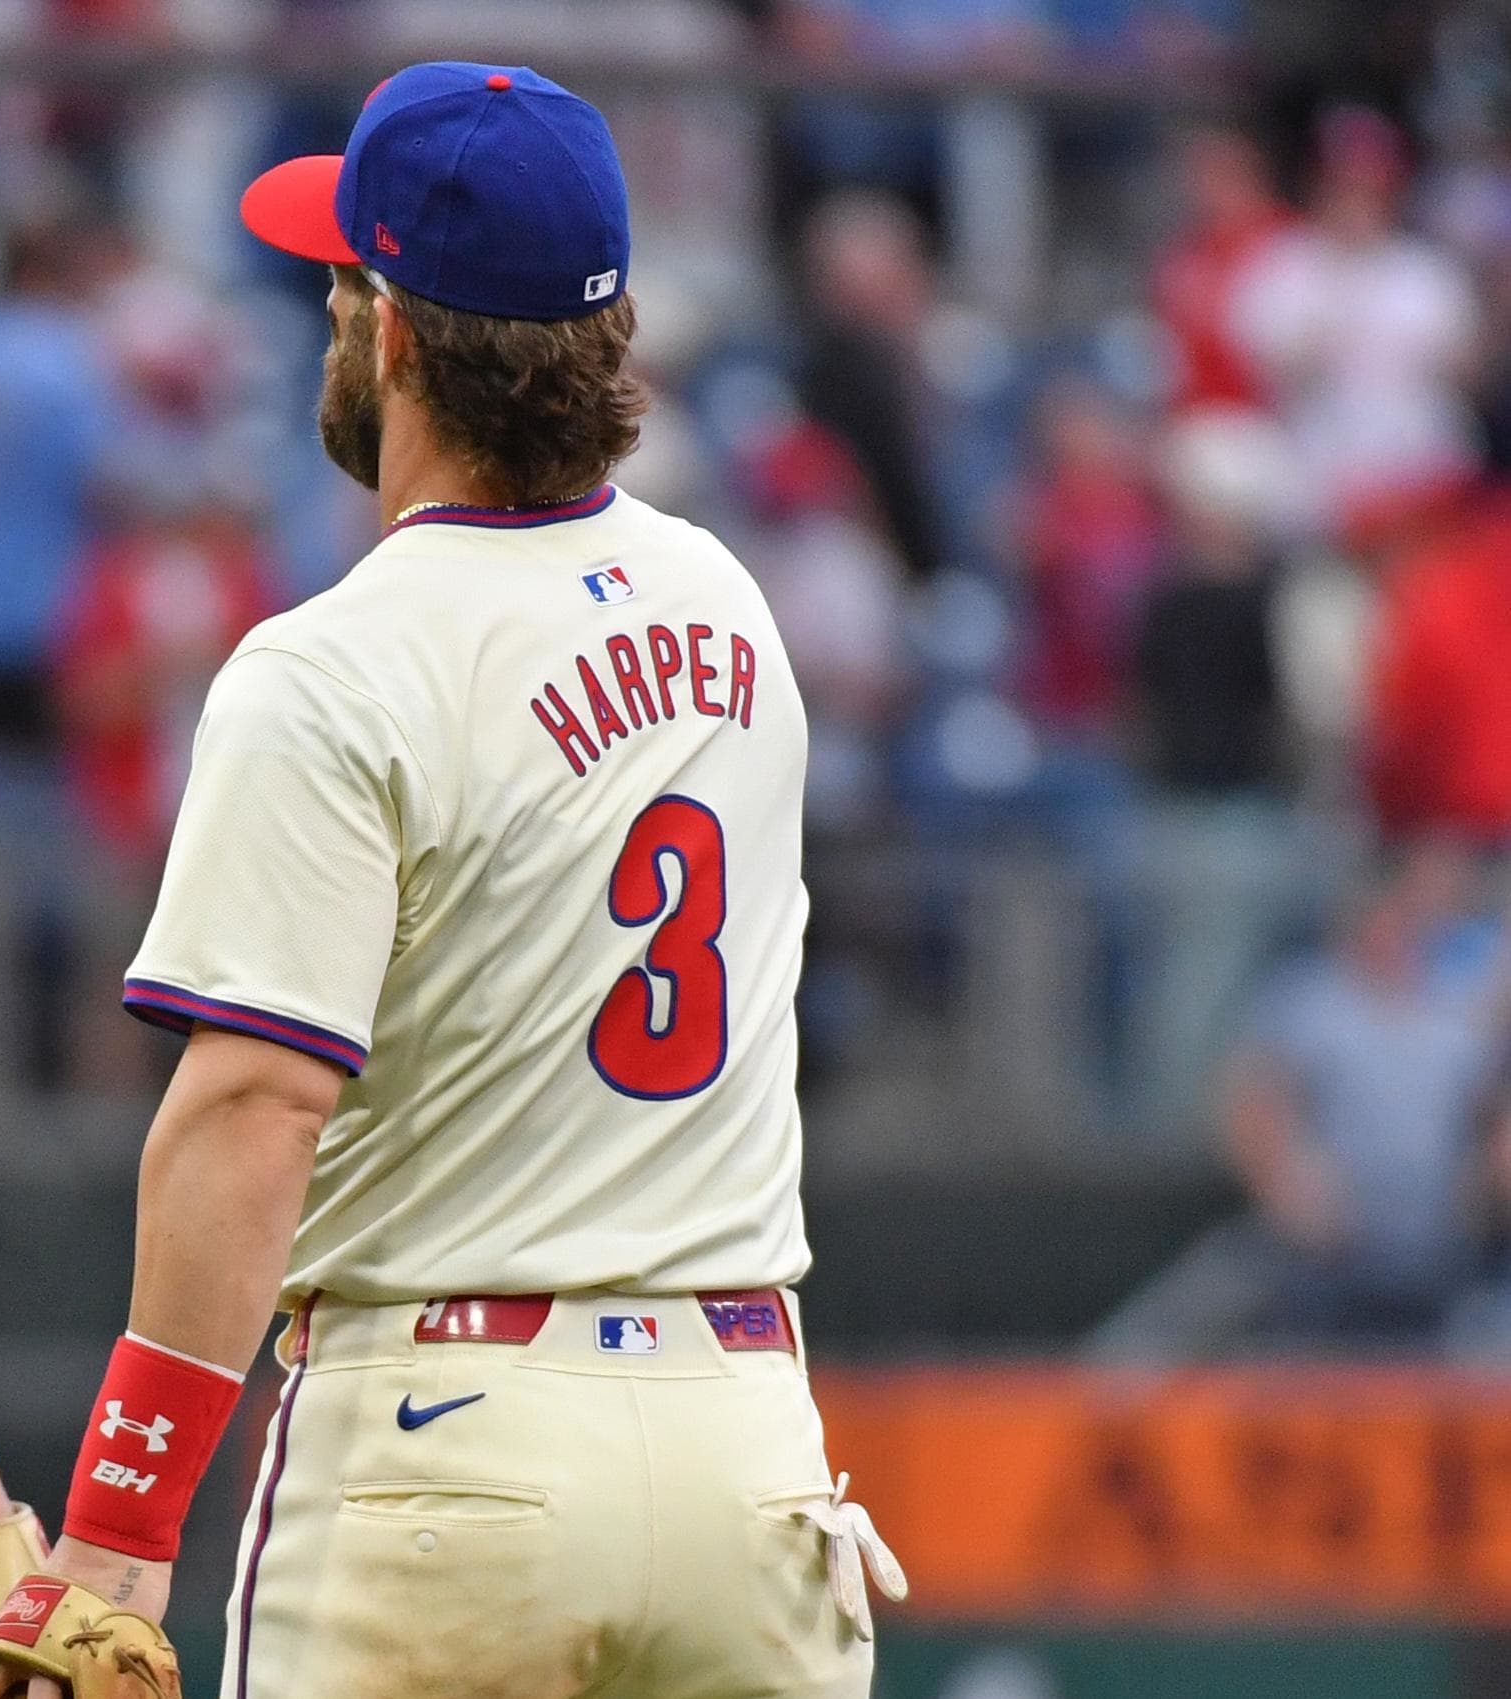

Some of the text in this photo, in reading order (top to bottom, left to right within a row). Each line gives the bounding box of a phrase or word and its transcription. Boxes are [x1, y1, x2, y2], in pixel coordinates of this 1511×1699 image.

[530, 624, 756, 777] HARPER
[587, 793, 727, 1101] 3
[90, 1458, 159, 1495] BH
